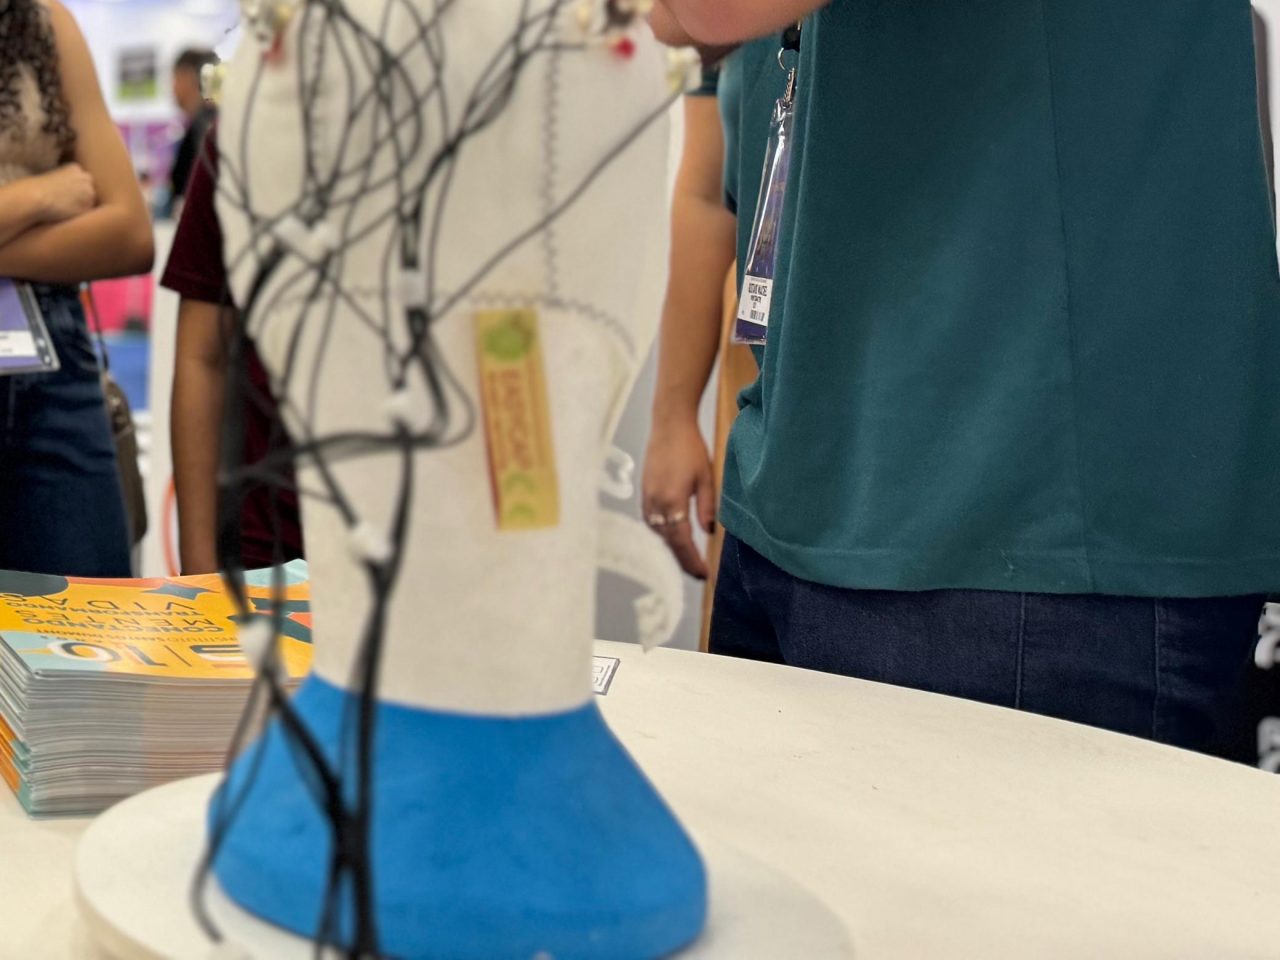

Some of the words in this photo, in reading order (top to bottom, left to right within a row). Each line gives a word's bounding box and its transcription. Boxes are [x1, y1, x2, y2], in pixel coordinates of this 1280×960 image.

[5, 601, 205, 616] TRANSFORMANDO
[14, 609, 217, 626] MENTES
[22, 618, 224, 633] CONECTANDO
